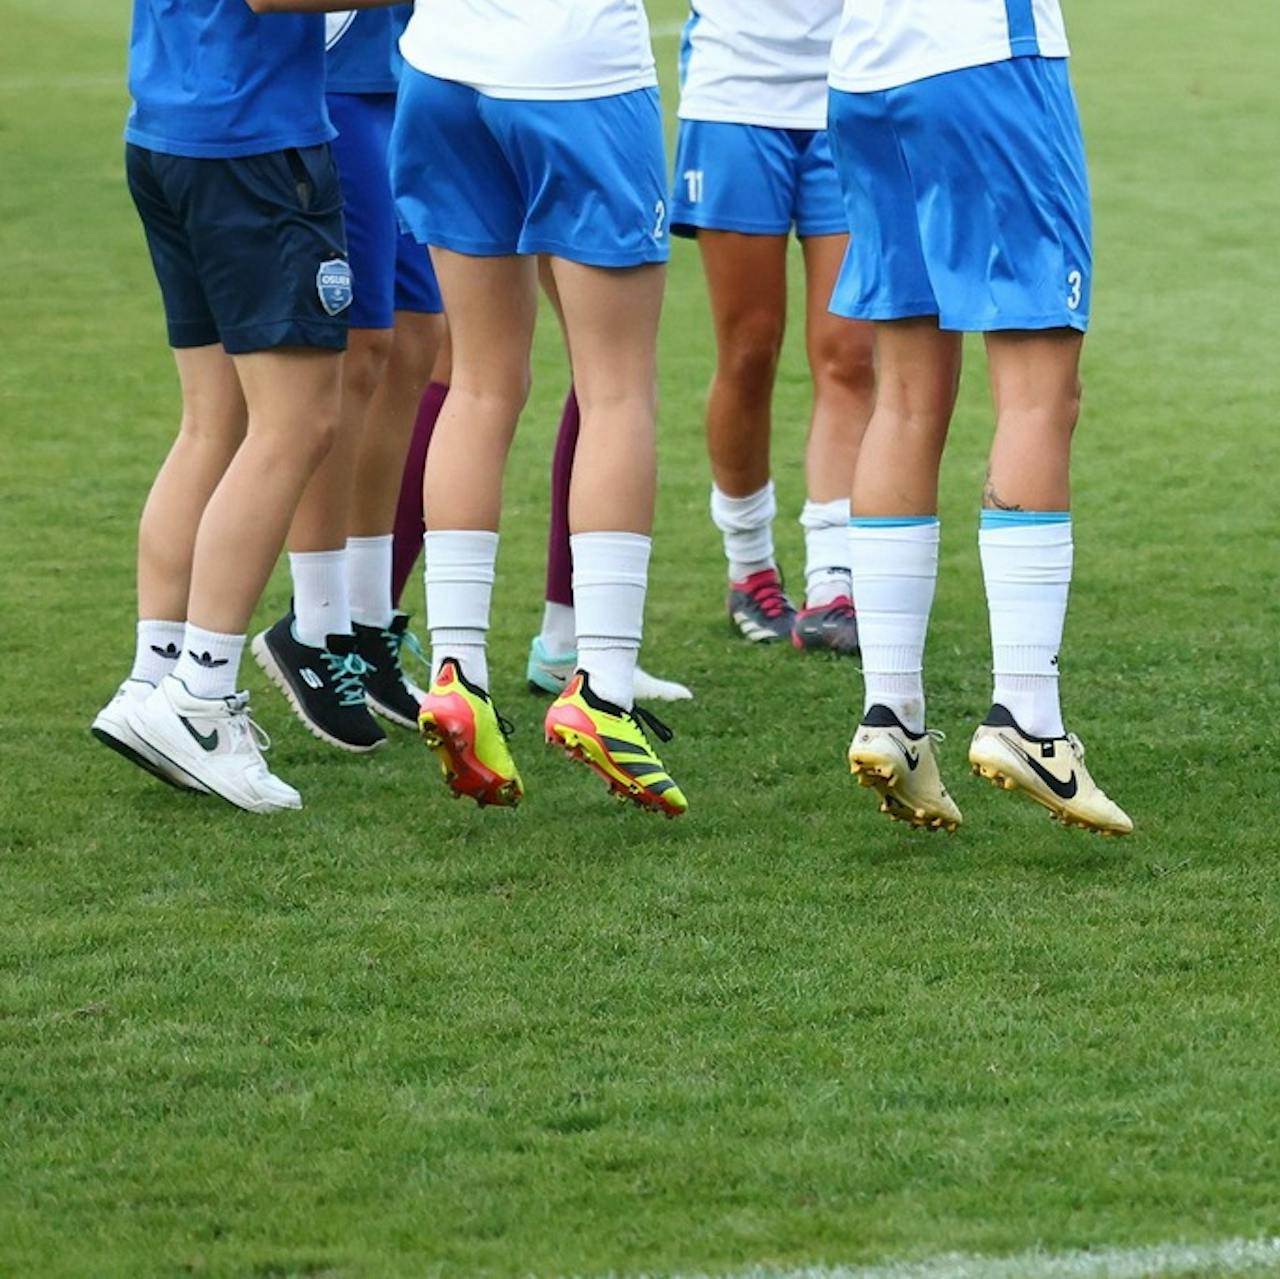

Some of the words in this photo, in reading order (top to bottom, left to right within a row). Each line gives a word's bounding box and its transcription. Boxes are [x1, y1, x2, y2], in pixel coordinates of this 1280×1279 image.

[684, 170, 704, 204] 11
[654, 200, 666, 238] 2
[1067, 270, 1082, 310] 3
